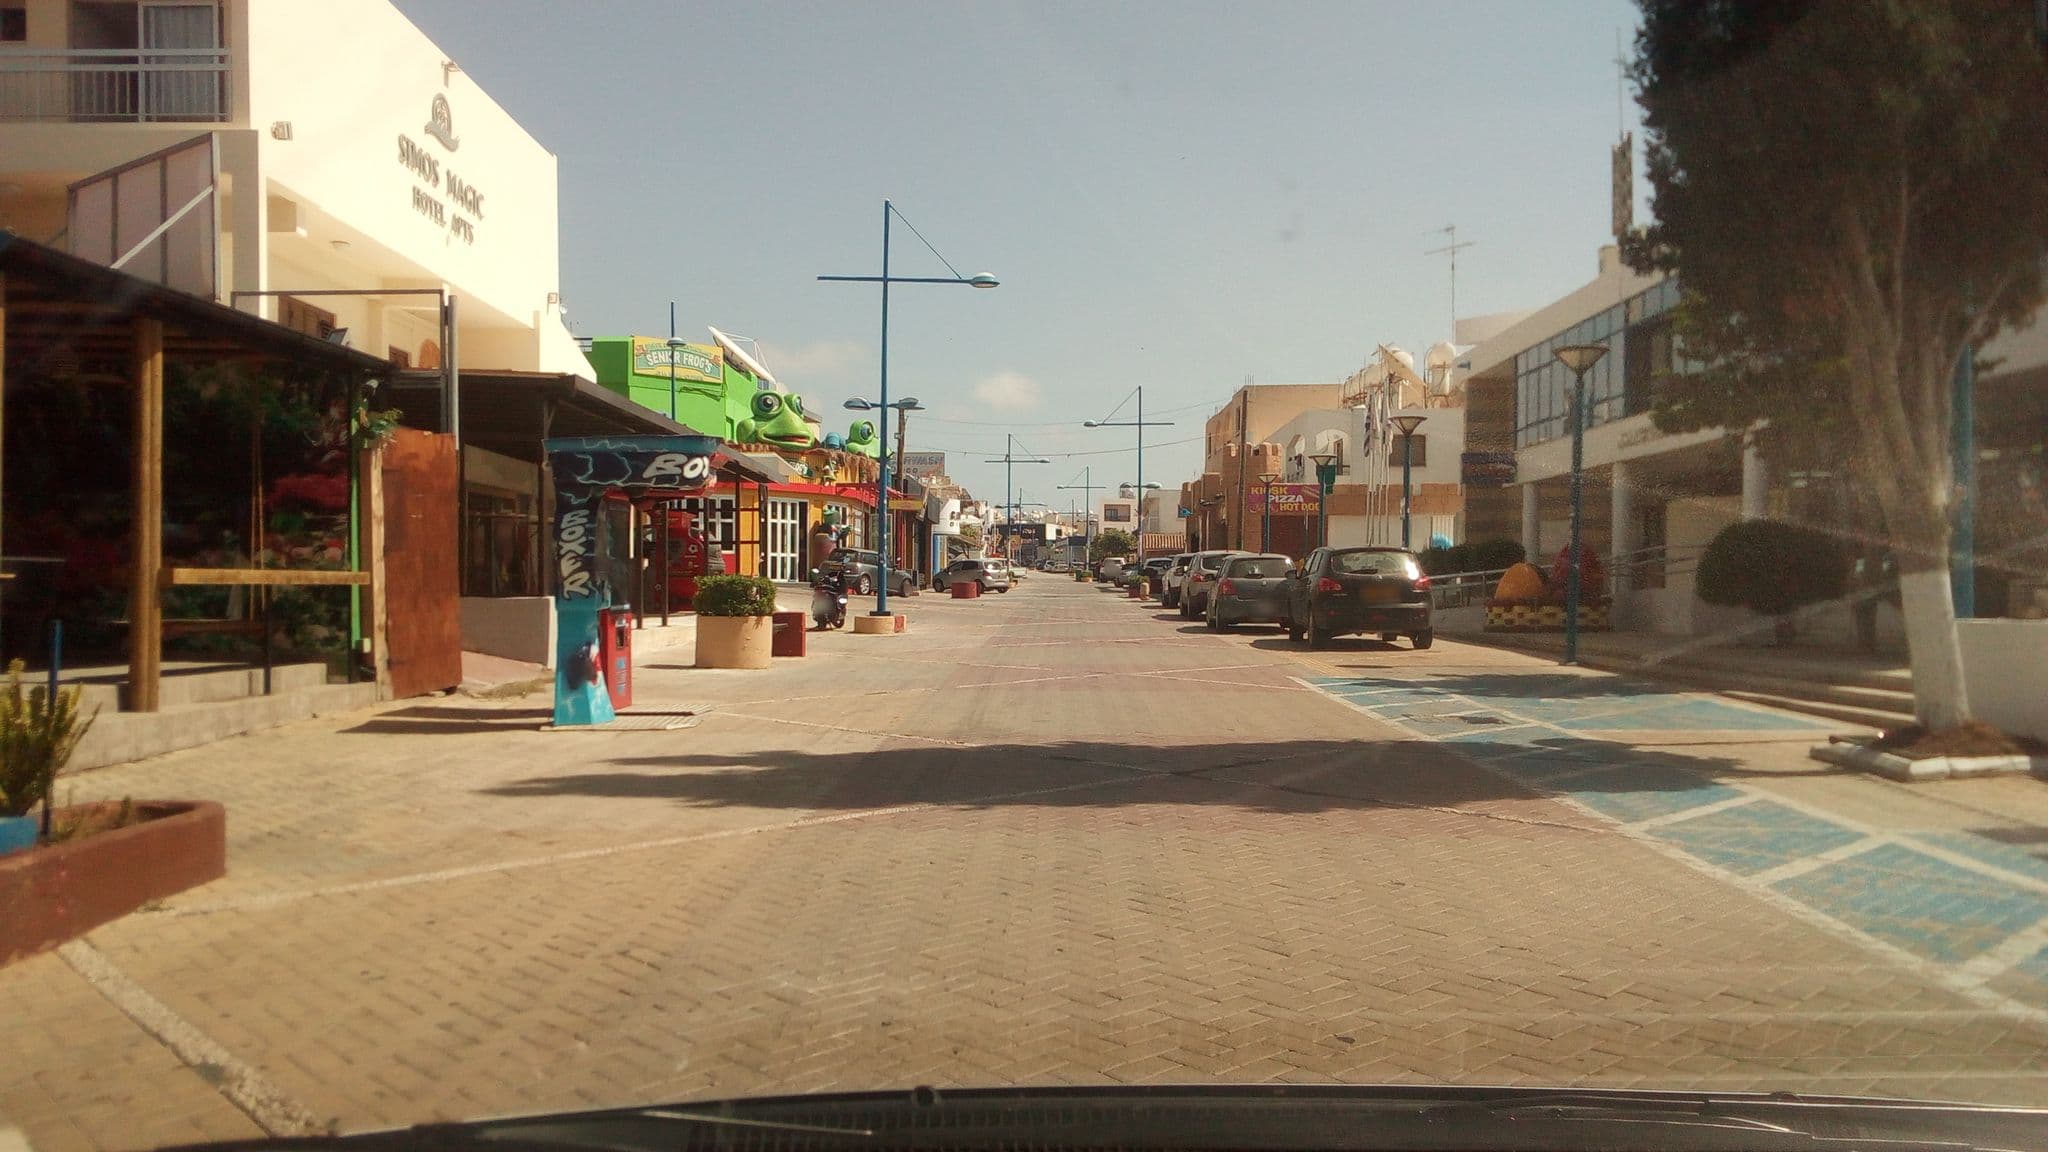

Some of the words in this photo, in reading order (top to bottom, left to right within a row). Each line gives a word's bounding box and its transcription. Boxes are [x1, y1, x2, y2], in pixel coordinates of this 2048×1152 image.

[399, 134, 439, 187] SIMOS
[446, 168, 484, 221] MAGIC
[412, 184, 446, 228] HOTEL
[683, 352, 712, 373] FROG'S
[1269, 495, 1303, 503] PIZZA
[1279, 503, 1300, 511] HOT
[560, 509, 590, 599] BOXER
